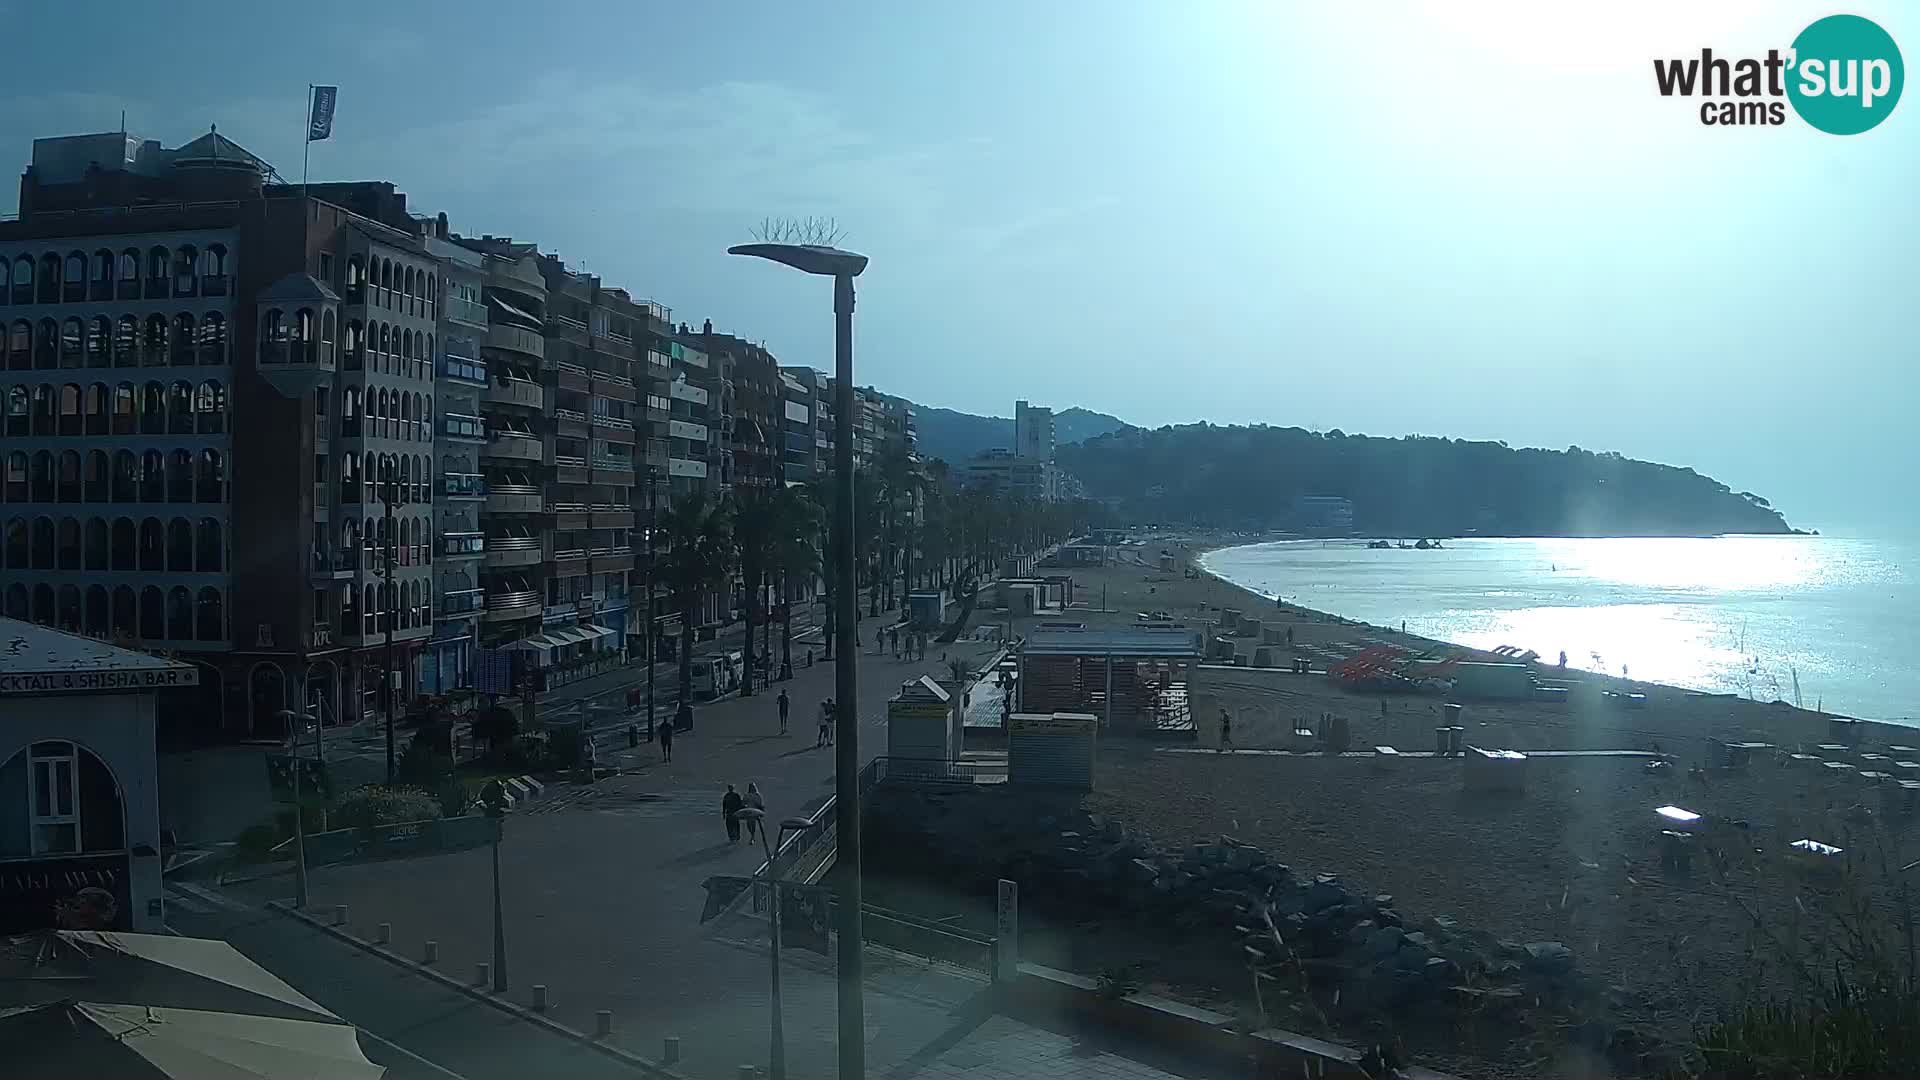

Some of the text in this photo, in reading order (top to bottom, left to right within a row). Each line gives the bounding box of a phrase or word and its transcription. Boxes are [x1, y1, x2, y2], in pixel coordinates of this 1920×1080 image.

[313, 630, 332, 647] KFC
[63, 674, 74, 689] &
[79, 672, 139, 689] SHISHA
[145, 670, 177, 685] BAR
